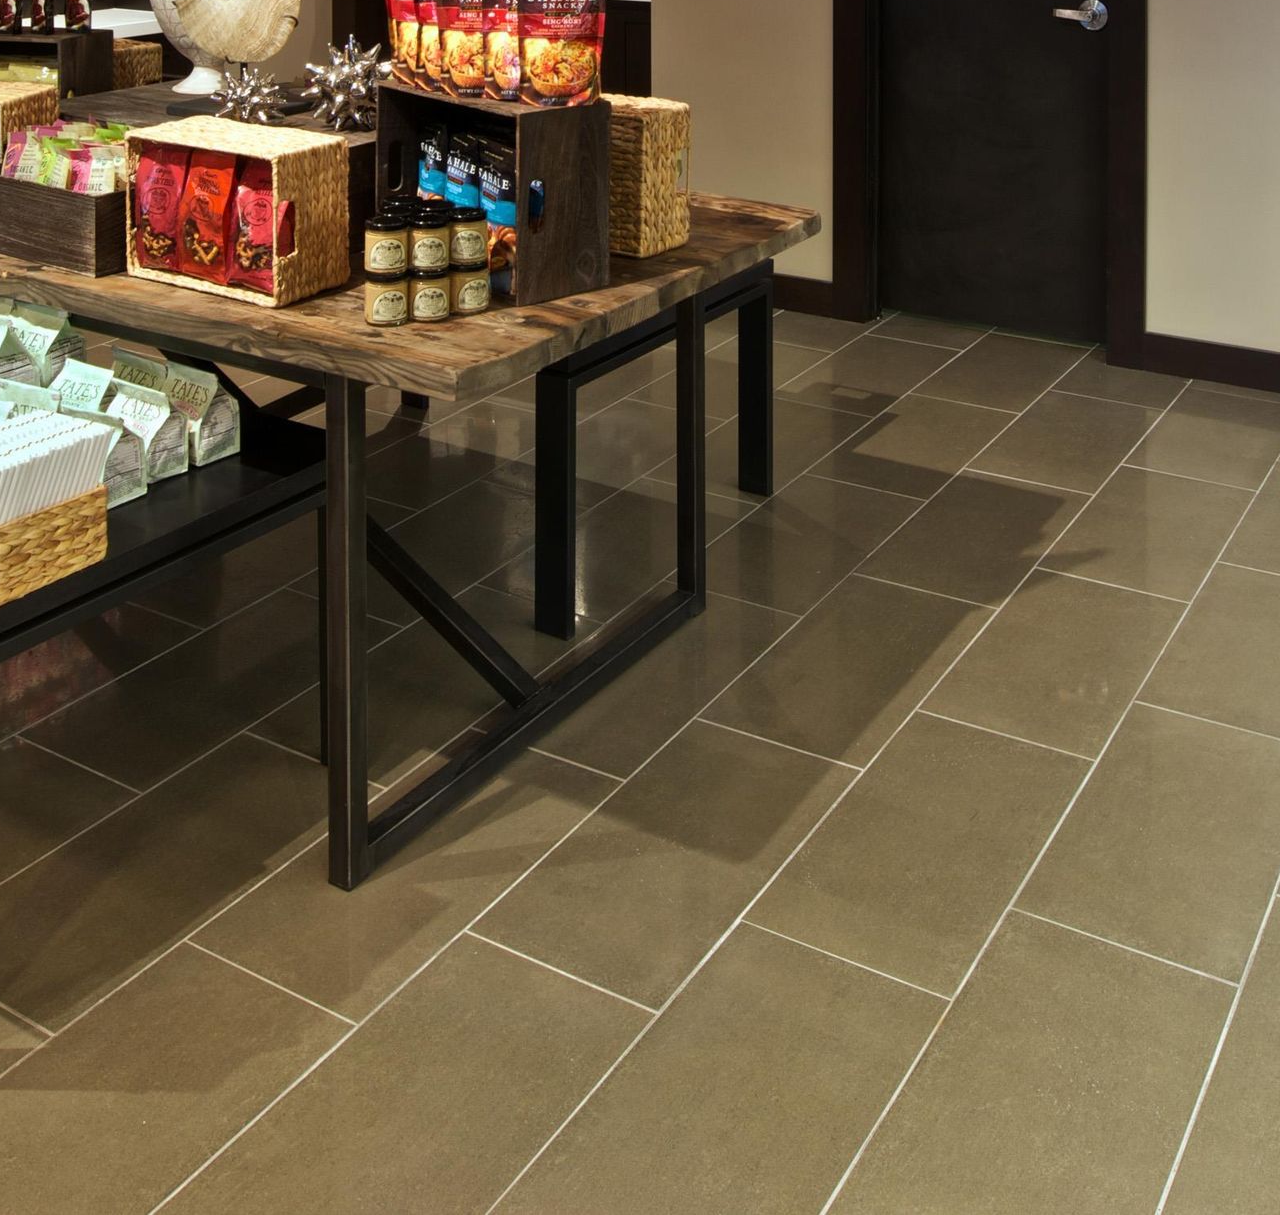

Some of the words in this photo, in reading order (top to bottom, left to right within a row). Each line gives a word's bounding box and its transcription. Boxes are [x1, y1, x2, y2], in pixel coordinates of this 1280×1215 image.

[542, 2, 585, 10] SNACKS
[447, 154, 477, 175] AHALE
[118, 364, 159, 387] TATE'S
[58, 378, 102, 400] TATE'S
[171, 377, 211, 403] TATE'S
